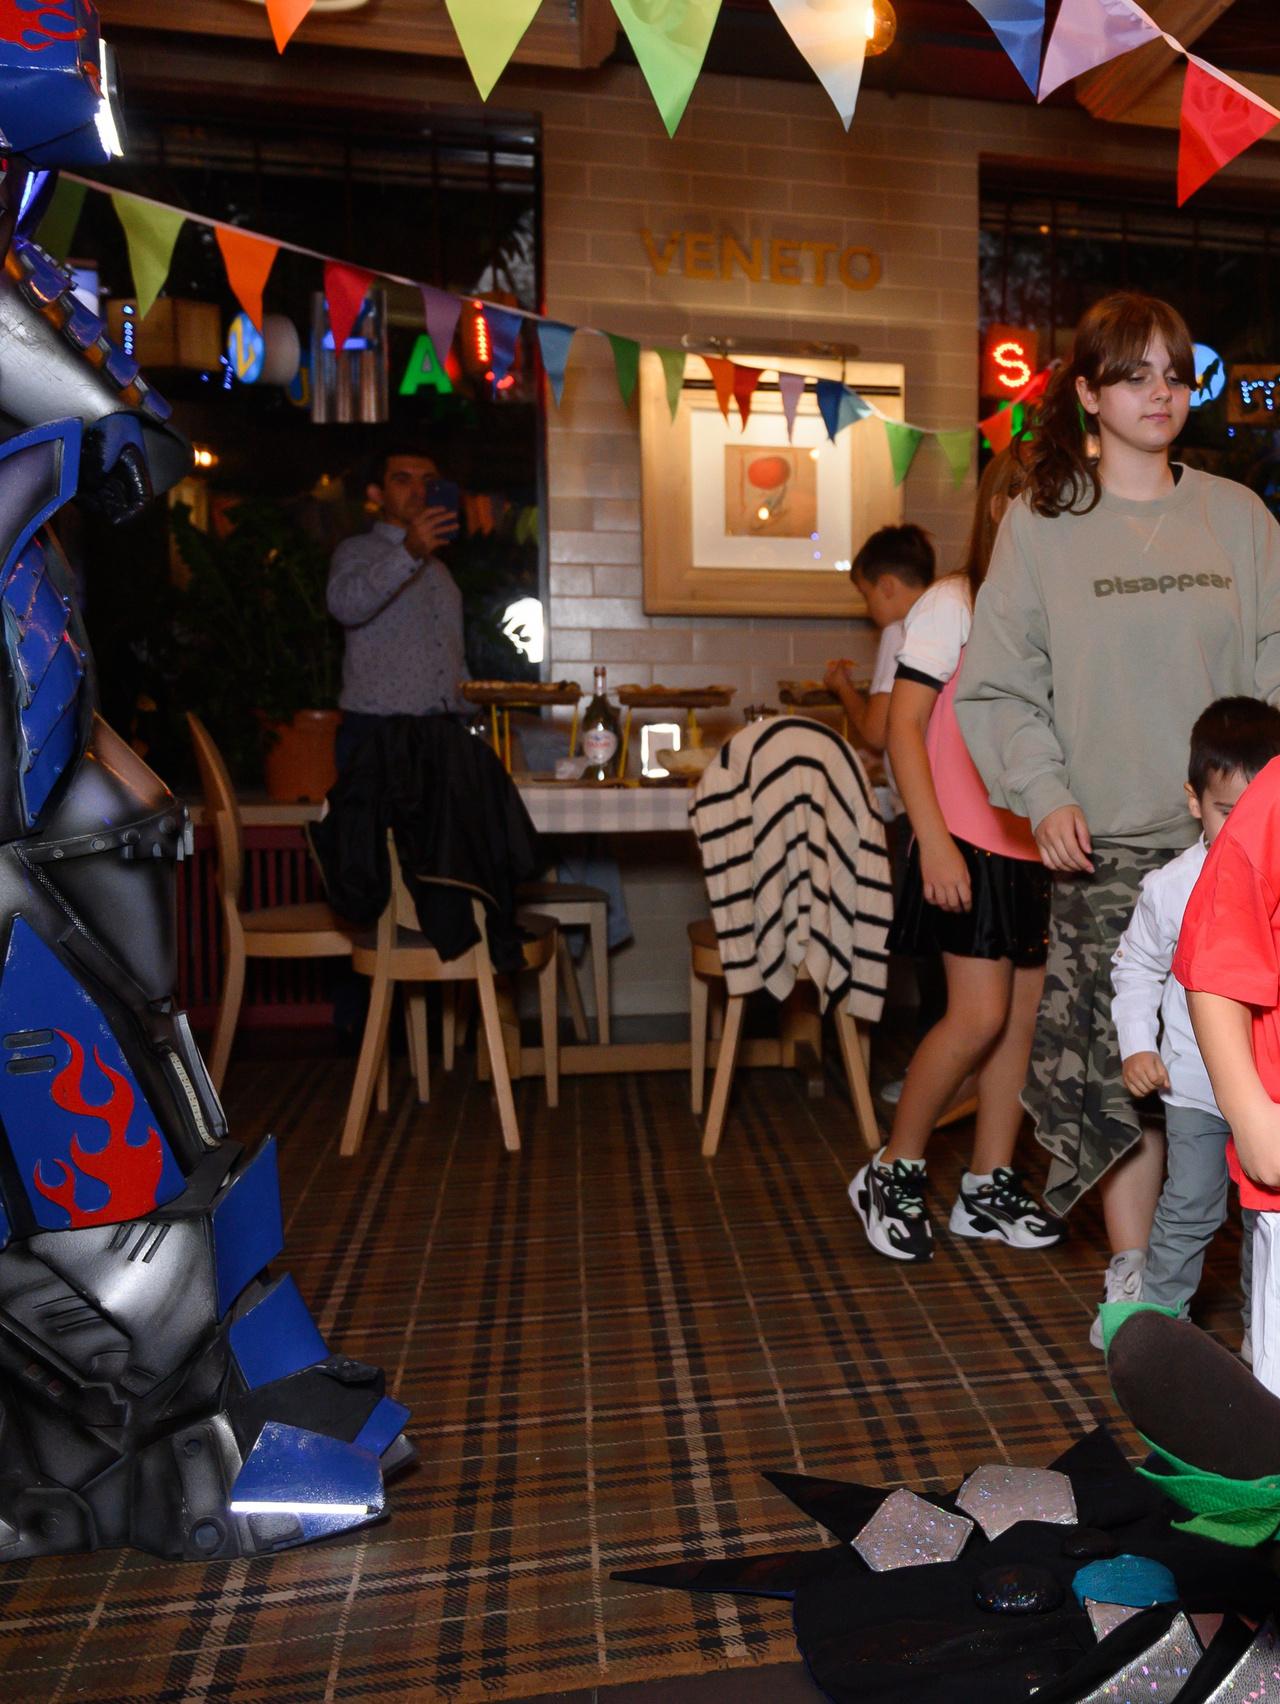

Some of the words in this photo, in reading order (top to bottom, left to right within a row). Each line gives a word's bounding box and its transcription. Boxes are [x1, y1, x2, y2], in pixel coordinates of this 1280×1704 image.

[639, 229, 882, 291] VENETO
[400, 335, 453, 394] A
[993, 342, 1032, 388] S
[1093, 573, 1233, 598] Disappear
